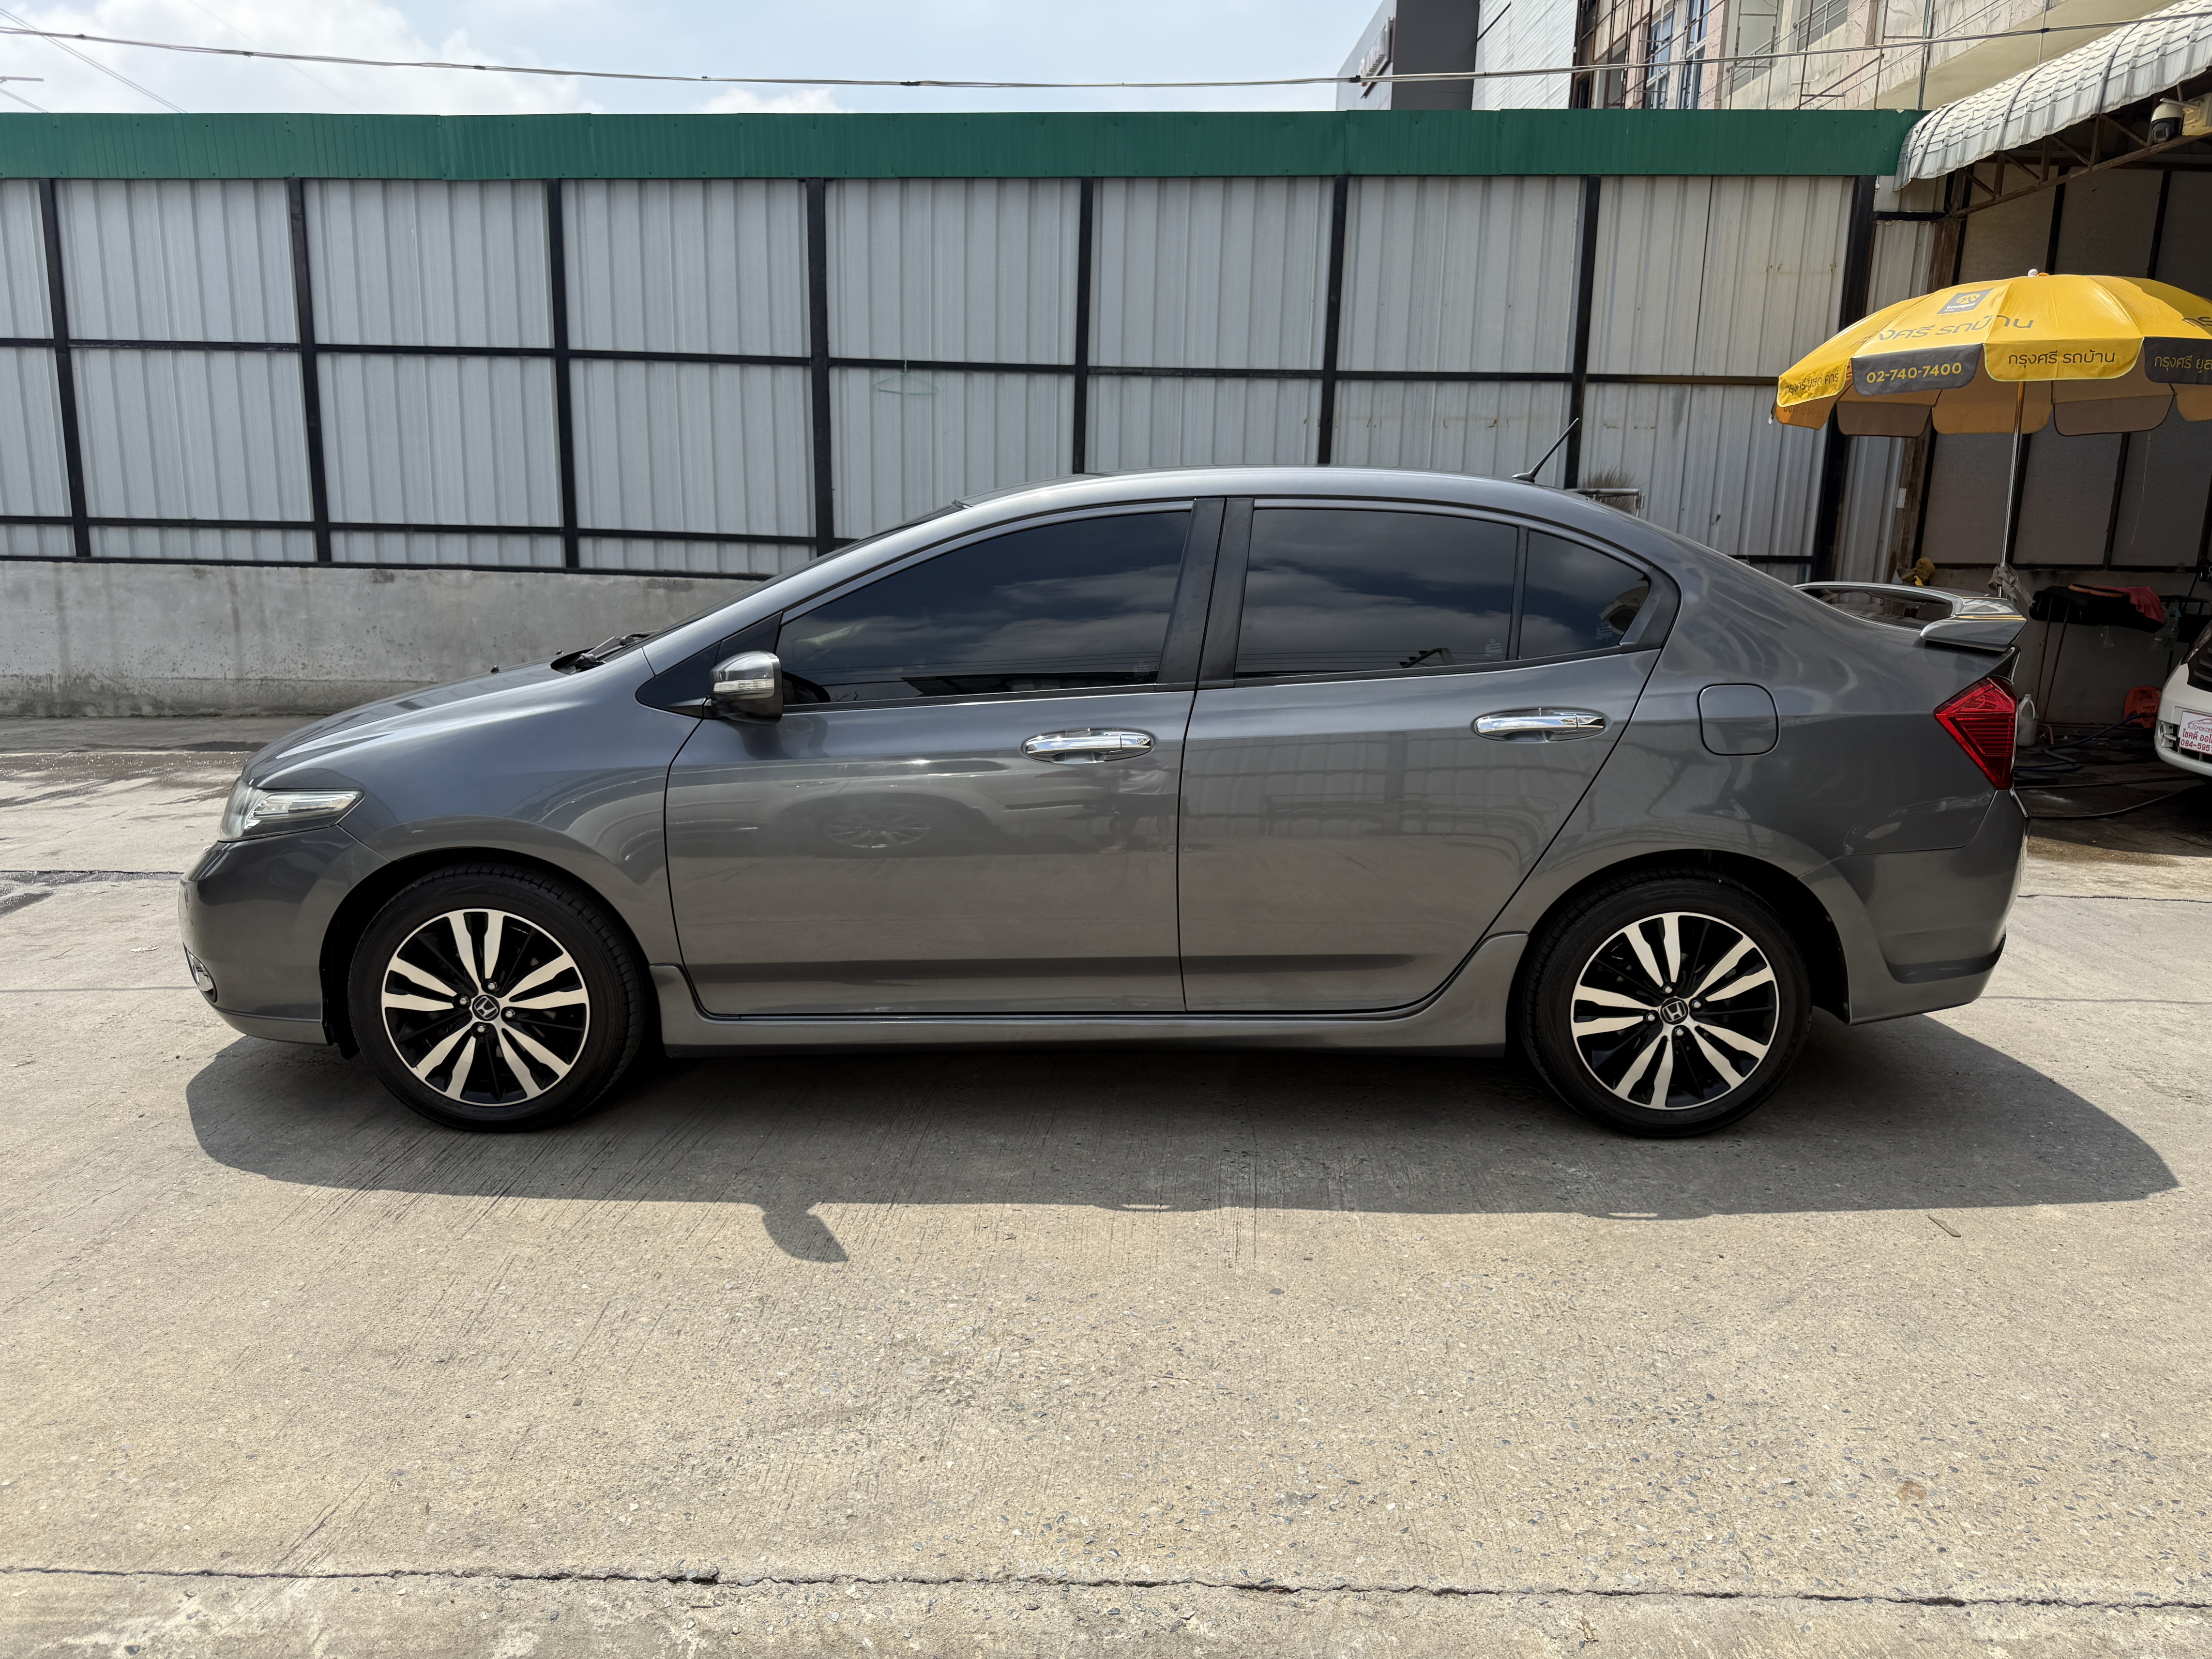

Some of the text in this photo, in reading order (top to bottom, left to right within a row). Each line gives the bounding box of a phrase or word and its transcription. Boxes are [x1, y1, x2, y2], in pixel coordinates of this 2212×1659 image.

[1935, 315, 2034, 335] รถบ้าน
[2009, 349, 2115, 368] กรุงศรี รถบ้าน
[2154, 355, 2193, 371] กรุงศรี
[1866, 362, 1962, 383] 02-740-7400
[1785, 378, 1806, 396] กรุงศรี
[2182, 728, 2212, 744] โชคดี ออโ
[2181, 739, 2212, 753] 084-595
